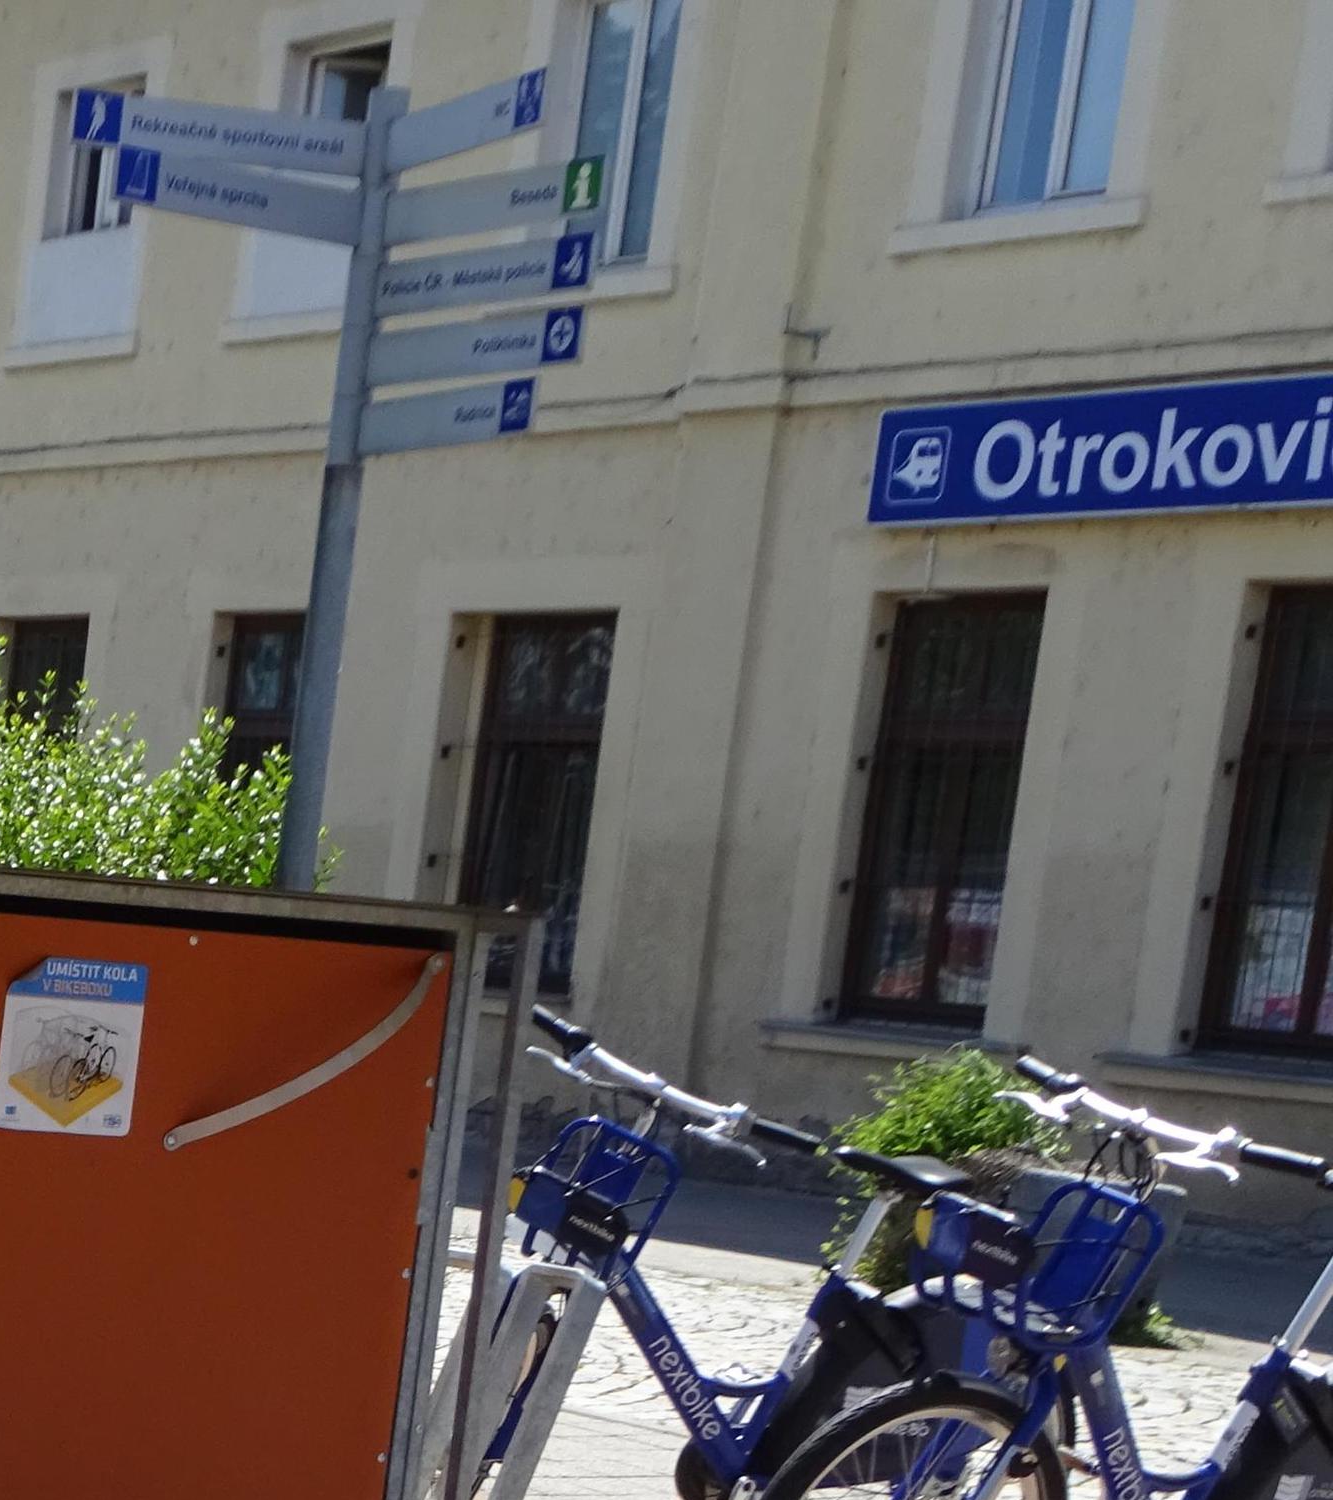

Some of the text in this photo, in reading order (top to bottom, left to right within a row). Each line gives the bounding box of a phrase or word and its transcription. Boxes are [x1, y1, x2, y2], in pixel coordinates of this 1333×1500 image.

[973, 396, 1333, 500] Otrokovi
[47, 960, 138, 982] UMÍSTIT KOLA
[42, 979, 113, 996] V BIKEBOXU
[568, 1214, 616, 1242] nextbike
[648, 1334, 722, 1440] nextbike
